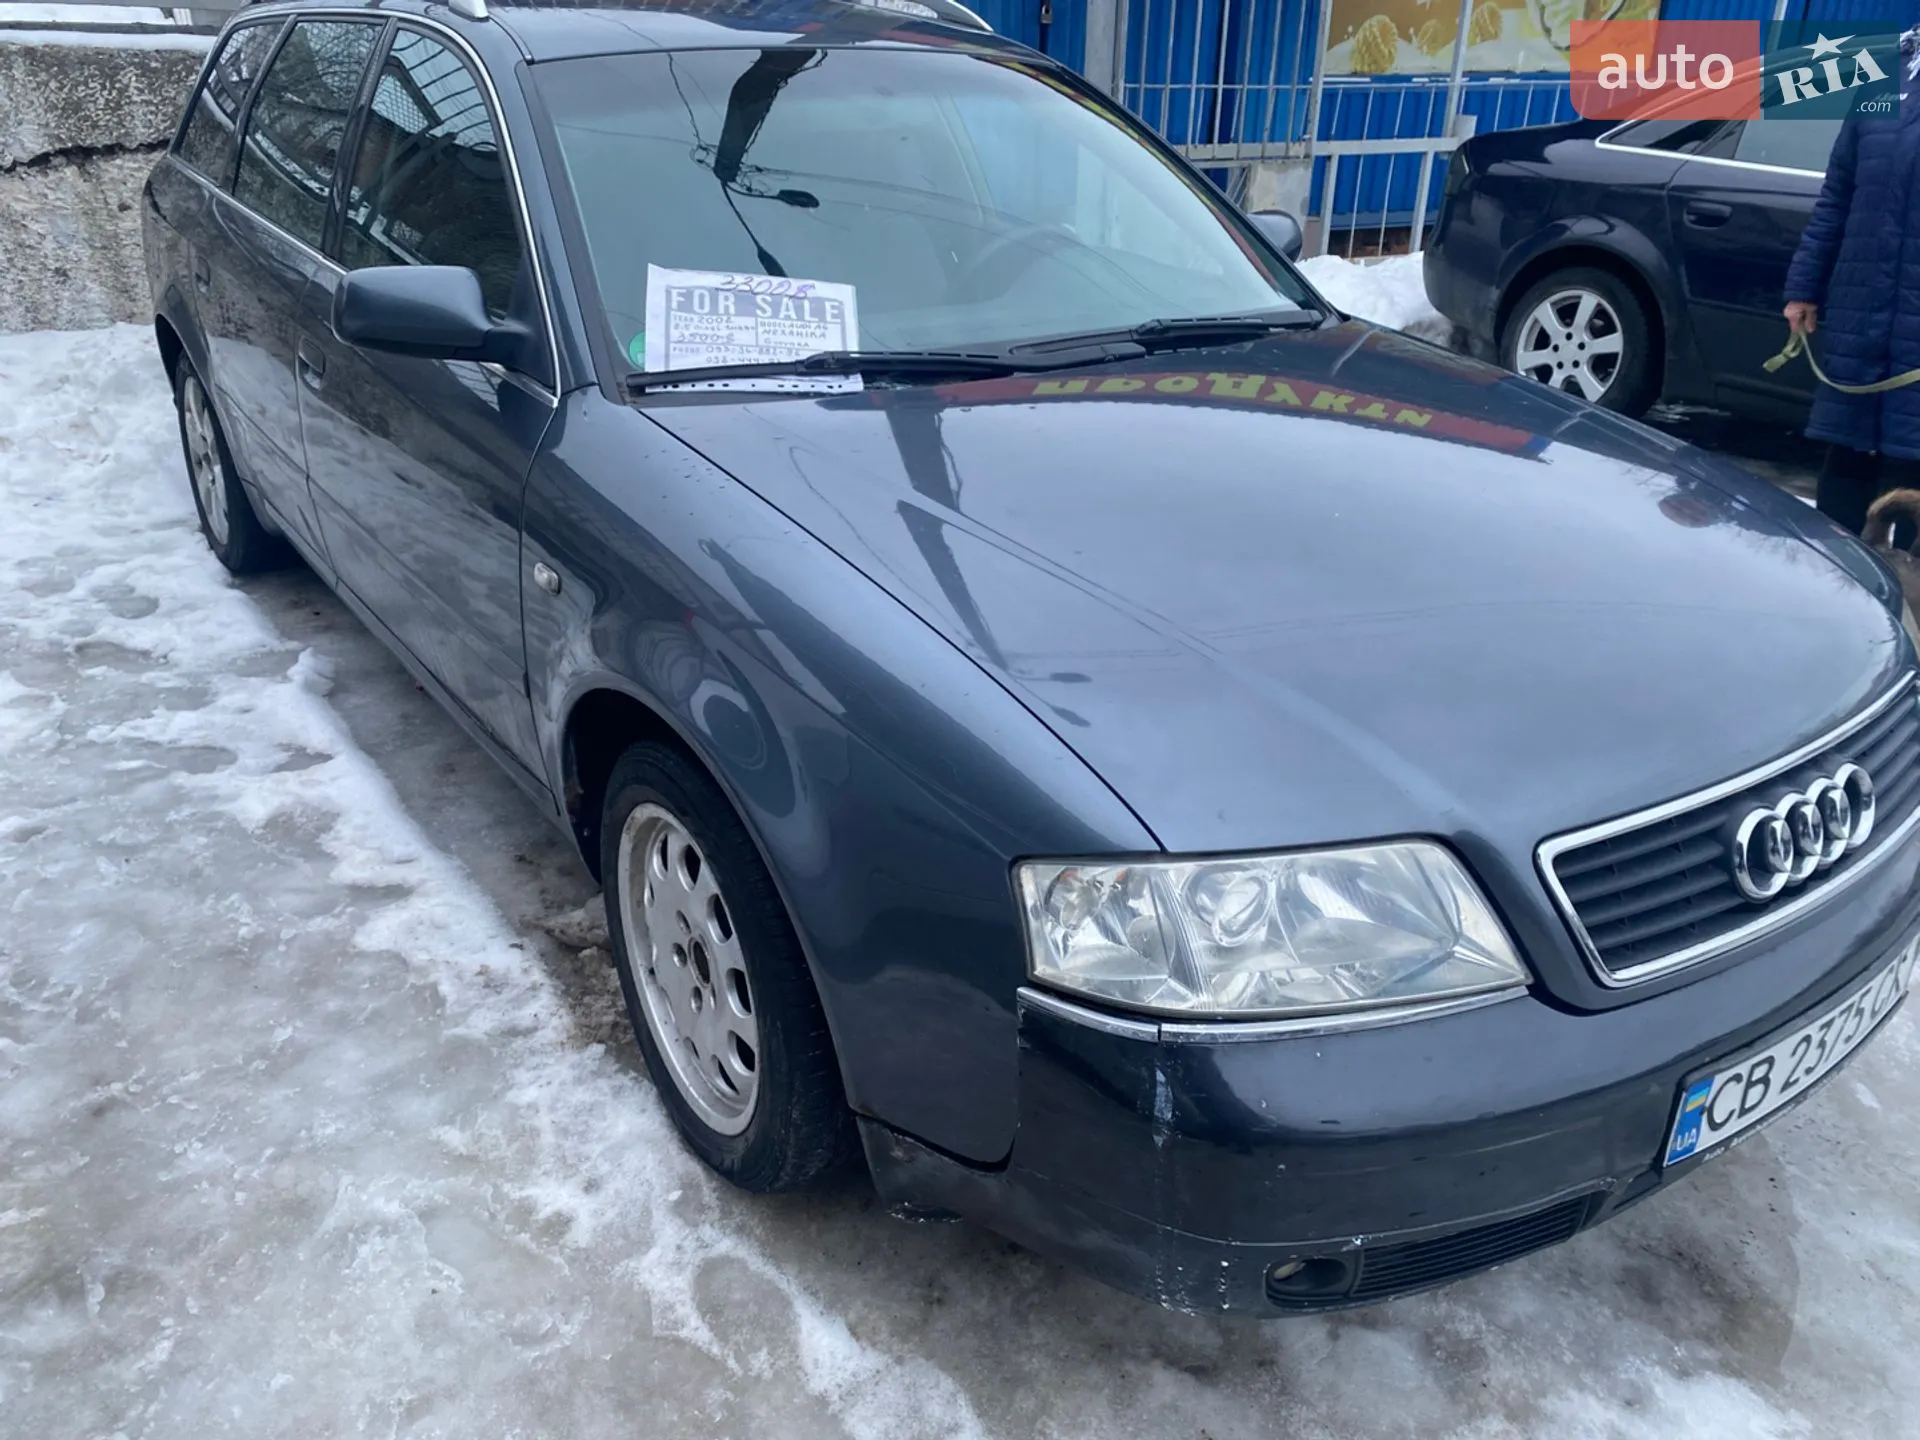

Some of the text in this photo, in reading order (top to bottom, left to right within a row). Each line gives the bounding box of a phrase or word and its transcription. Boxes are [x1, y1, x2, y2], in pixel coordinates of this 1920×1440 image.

[671, 289, 842, 323] FOR SALE
[1706, 1055, 1775, 1132] CB
[1779, 990, 1873, 1094] 2375
[1676, 1127, 1698, 1151] UA
